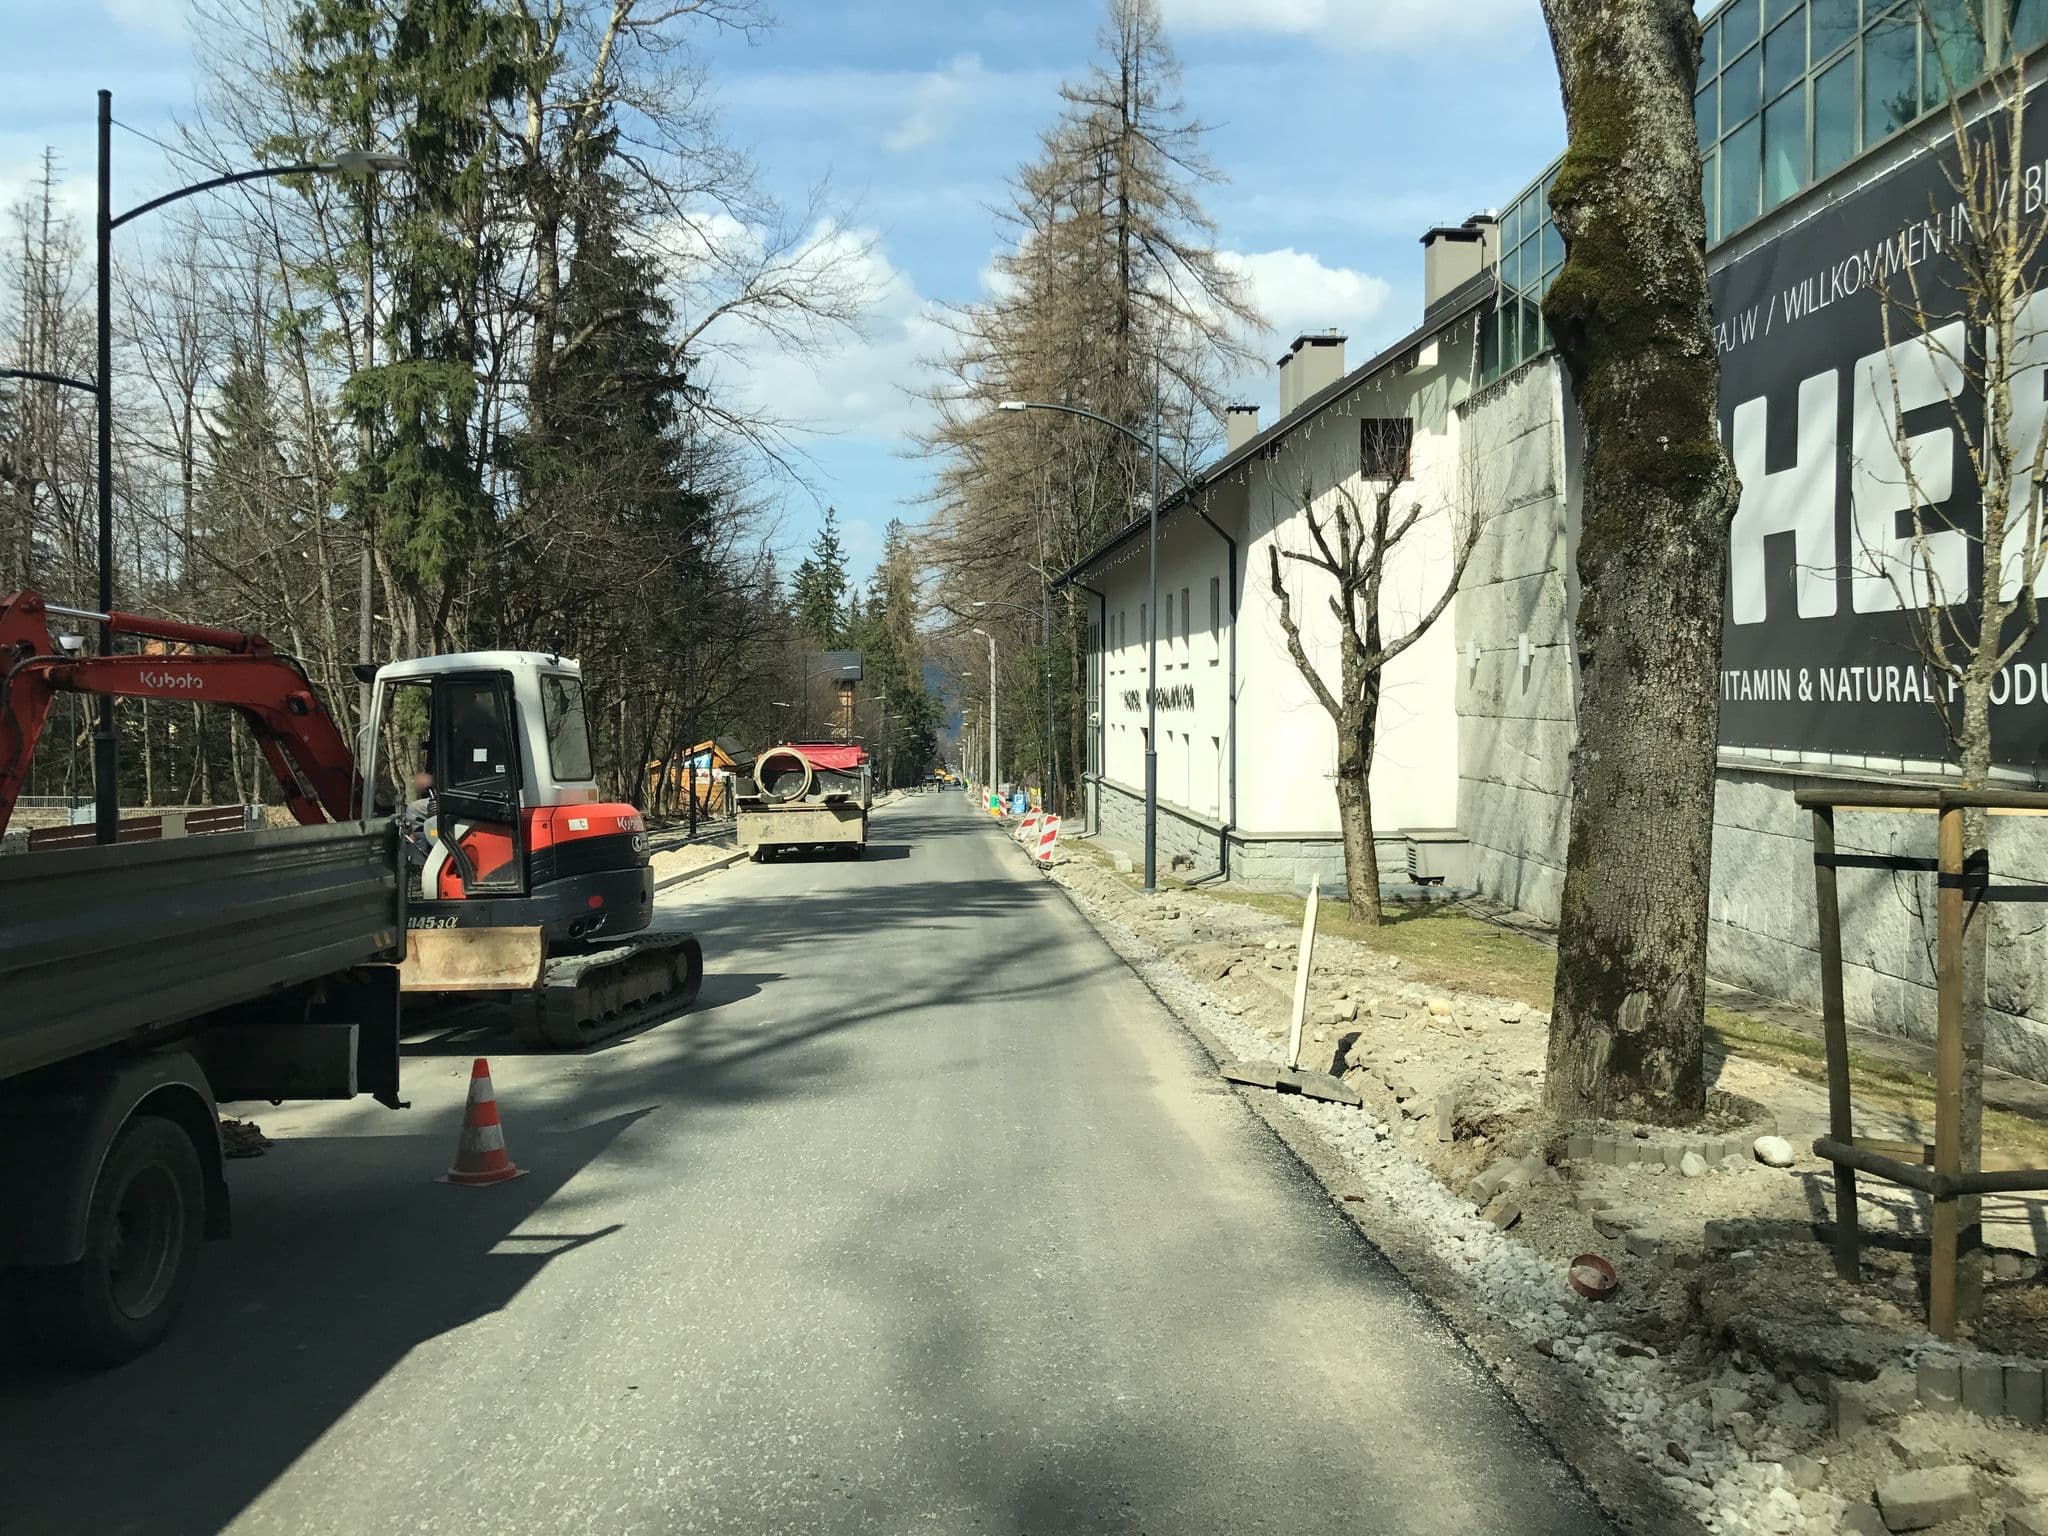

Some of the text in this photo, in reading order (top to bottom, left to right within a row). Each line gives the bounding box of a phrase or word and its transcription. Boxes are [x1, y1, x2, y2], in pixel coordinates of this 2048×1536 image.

[1740, 304, 1759, 344] W
[1783, 212, 1941, 324] WILLKOMMEN
[140, 671, 204, 689] Kubota
[1798, 667, 1813, 701] &
[1819, 665, 1936, 703] NATURAL
